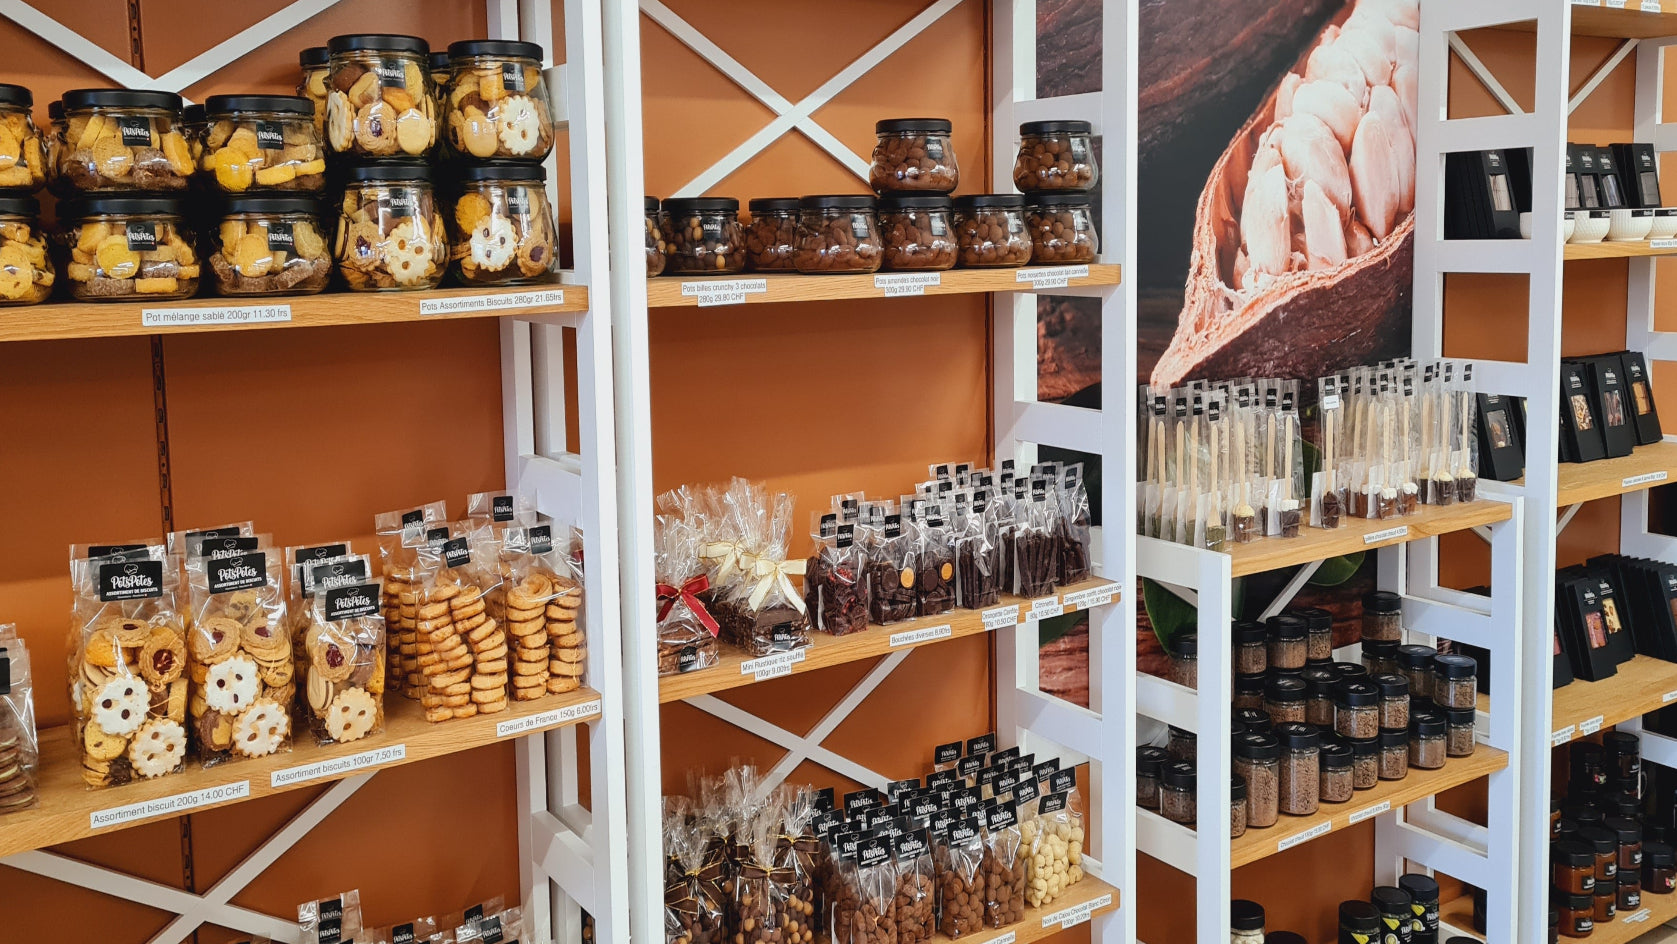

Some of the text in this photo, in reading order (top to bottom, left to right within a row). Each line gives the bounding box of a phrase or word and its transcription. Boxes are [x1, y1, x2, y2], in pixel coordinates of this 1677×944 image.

[683, 285, 695, 293] Pots
[697, 284, 711, 292] billes
[713, 283, 734, 292] crunchy
[741, 282, 766, 290] chocolats
[421, 303, 437, 311] Pots
[440, 300, 484, 309] Assortiments
[487, 298, 513, 306] Biscuits
[515, 296, 533, 305] 280gr
[731, 292, 744, 300] CHF
[146, 308, 288, 322] Pot mélange sablé 200gr 11.30 frs
[891, 634, 915, 644] Bouchées
[915, 631, 934, 640] diverses
[743, 663, 754, 671] Mini
[754, 659, 778, 669] Rustique
[786, 651, 804, 661] soufflé
[756, 669, 771, 678] 100gr
[500, 722, 524, 733] Coeurs
[525, 719, 534, 727] de
[535, 714, 558, 724] France
[560, 709, 575, 719] 150g
[275, 767, 321, 783] Assortiment
[322, 761, 350, 772] biscuits
[353, 756, 373, 766] 100gr
[392, 748, 402, 757] frs
[93, 785, 245, 824] Assortiment biscuit 200g 14.00 CHF
[1042, 918, 1052, 926] Noix
[1058, 911, 1071, 919] Cajou
[1071, 905, 1088, 915] Chocolat
